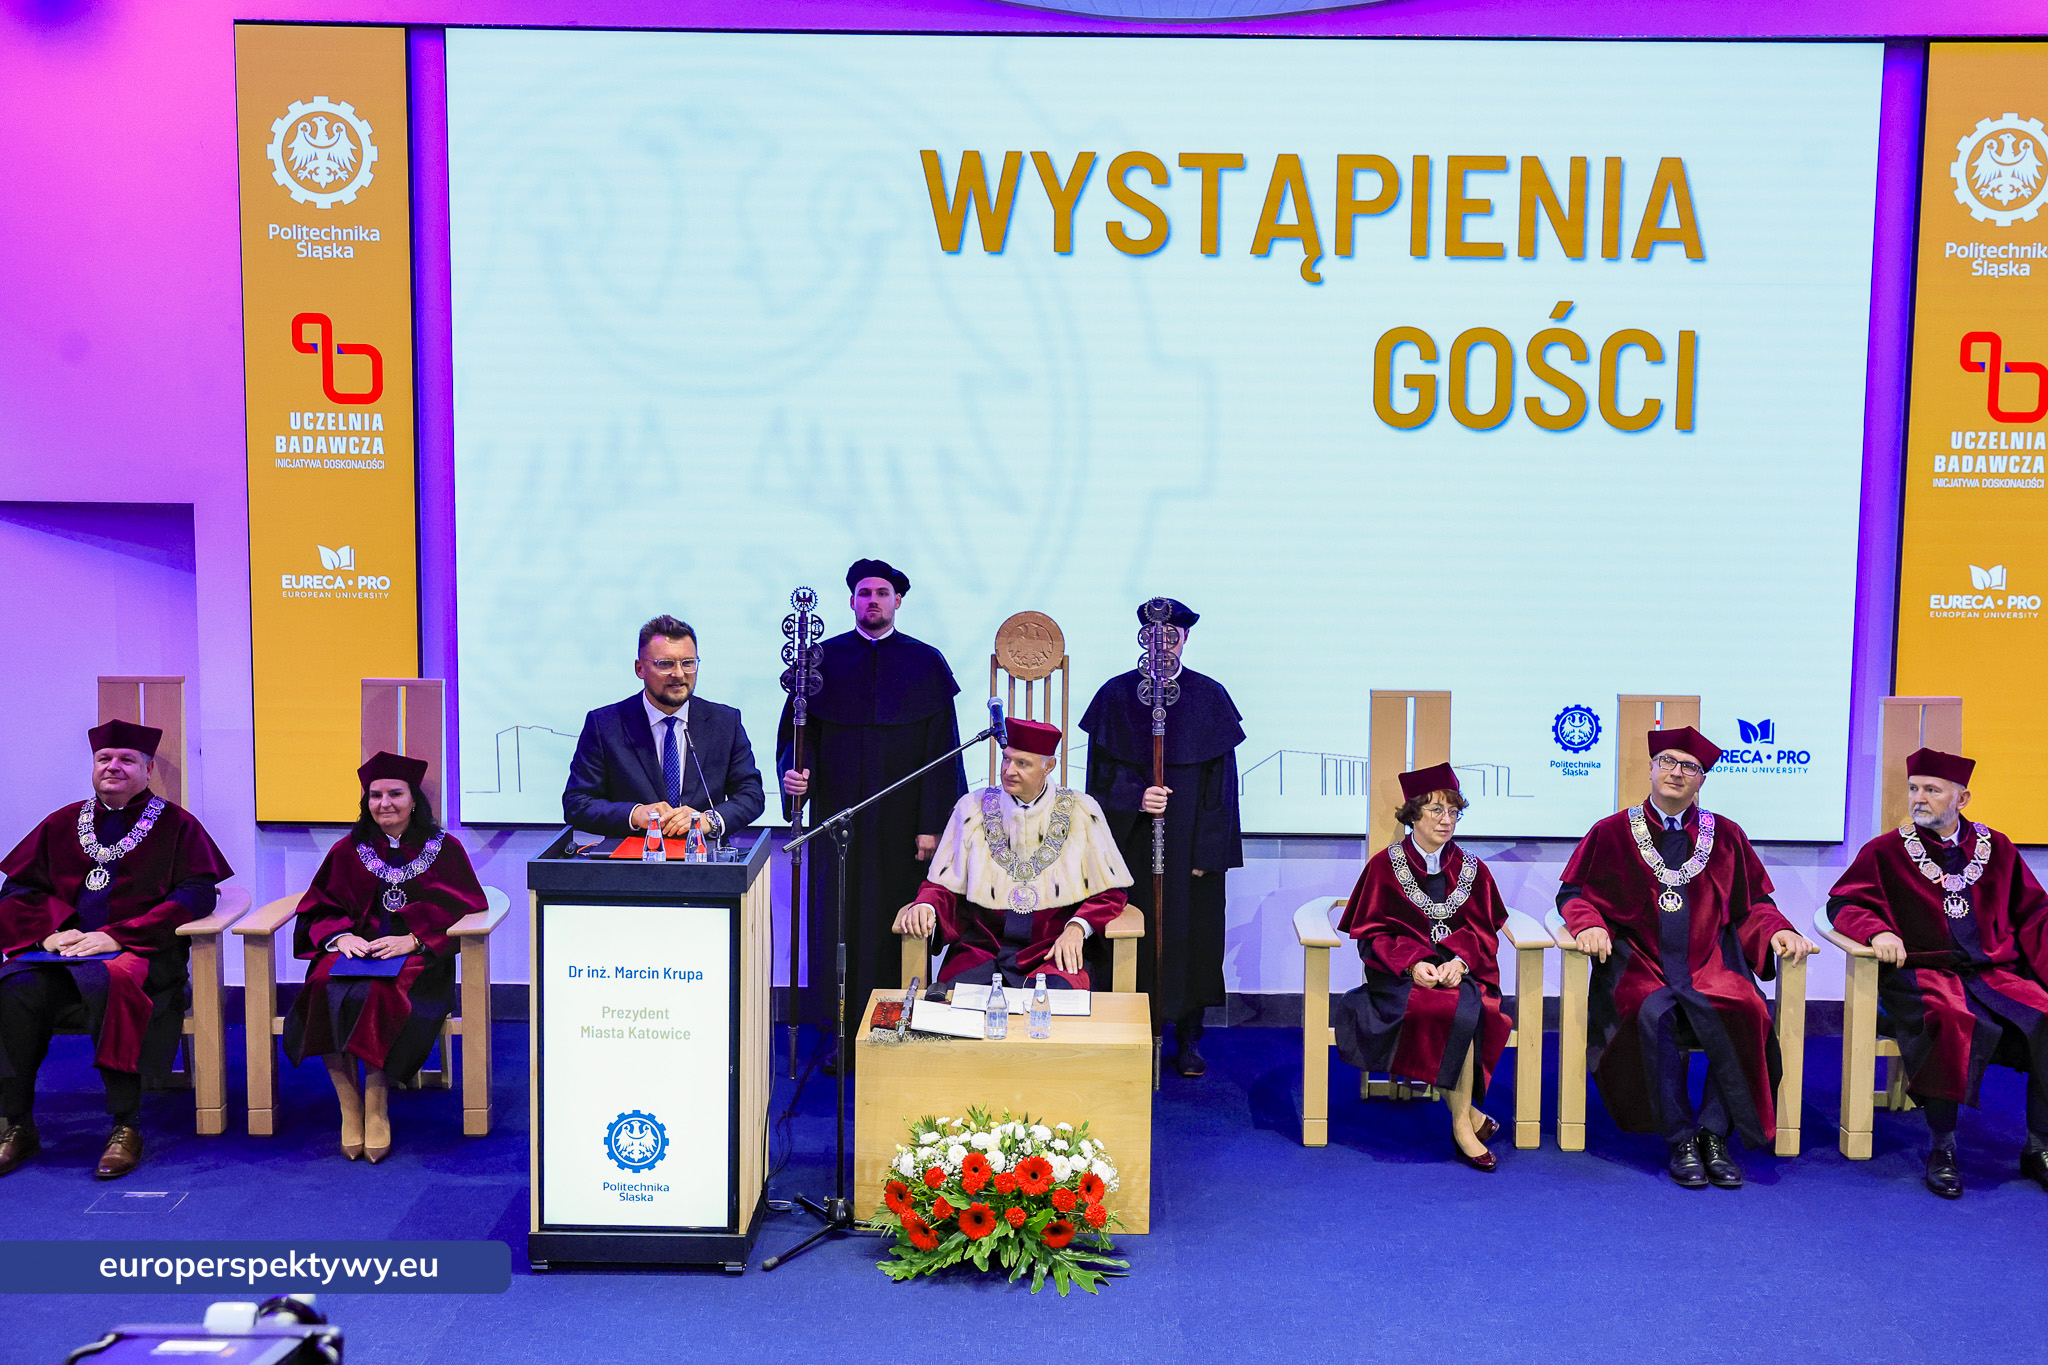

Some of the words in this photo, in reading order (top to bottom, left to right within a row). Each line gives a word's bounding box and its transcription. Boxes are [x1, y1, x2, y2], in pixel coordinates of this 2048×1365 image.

[920, 150, 1705, 284] WYSTĄPIENIA
[268, 224, 380, 242] Politechnika
[296, 240, 354, 260] Śląska
[1945, 242, 2048, 258] Politechnik
[1971, 258, 2031, 278] Śląska
[1373, 301, 1699, 432] GOŚCI
[289, 412, 384, 431] UCZELNIA
[275, 435, 385, 455] BADAWCZA
[1950, 431, 2046, 449] UCZELNIA
[275, 458, 322, 468] INICJATYWA
[323, 458, 385, 469] DOSKONAŁOŚCI
[1933, 454, 2045, 474] BADAWCZA
[1932, 478, 1980, 488] INICJATYWA
[1981, 477, 2045, 489] DOSKONAŁOŚCI
[281, 574, 346, 590] EURECA
[357, 575, 391, 590] PRO
[1929, 594, 1995, 610] EURECA
[2007, 595, 2042, 610] PRO
[1550, 760, 1601, 769] Politechnika
[1716, 749, 1763, 764] RECA
[1777, 750, 1811, 765] PRO
[1562, 768, 1589, 777] Śląska
[1751, 766, 1809, 774] UNIVERSITY
[568, 965, 584, 978] Dr
[587, 965, 611, 979] inż.
[614, 966, 660, 980] Marcin
[663, 967, 704, 983] Krupa
[602, 1006, 670, 1022] Prezydent
[580, 1025, 625, 1039] Miasta
[628, 1026, 691, 1040] Katowice
[603, 1182, 670, 1192] Politechnika
